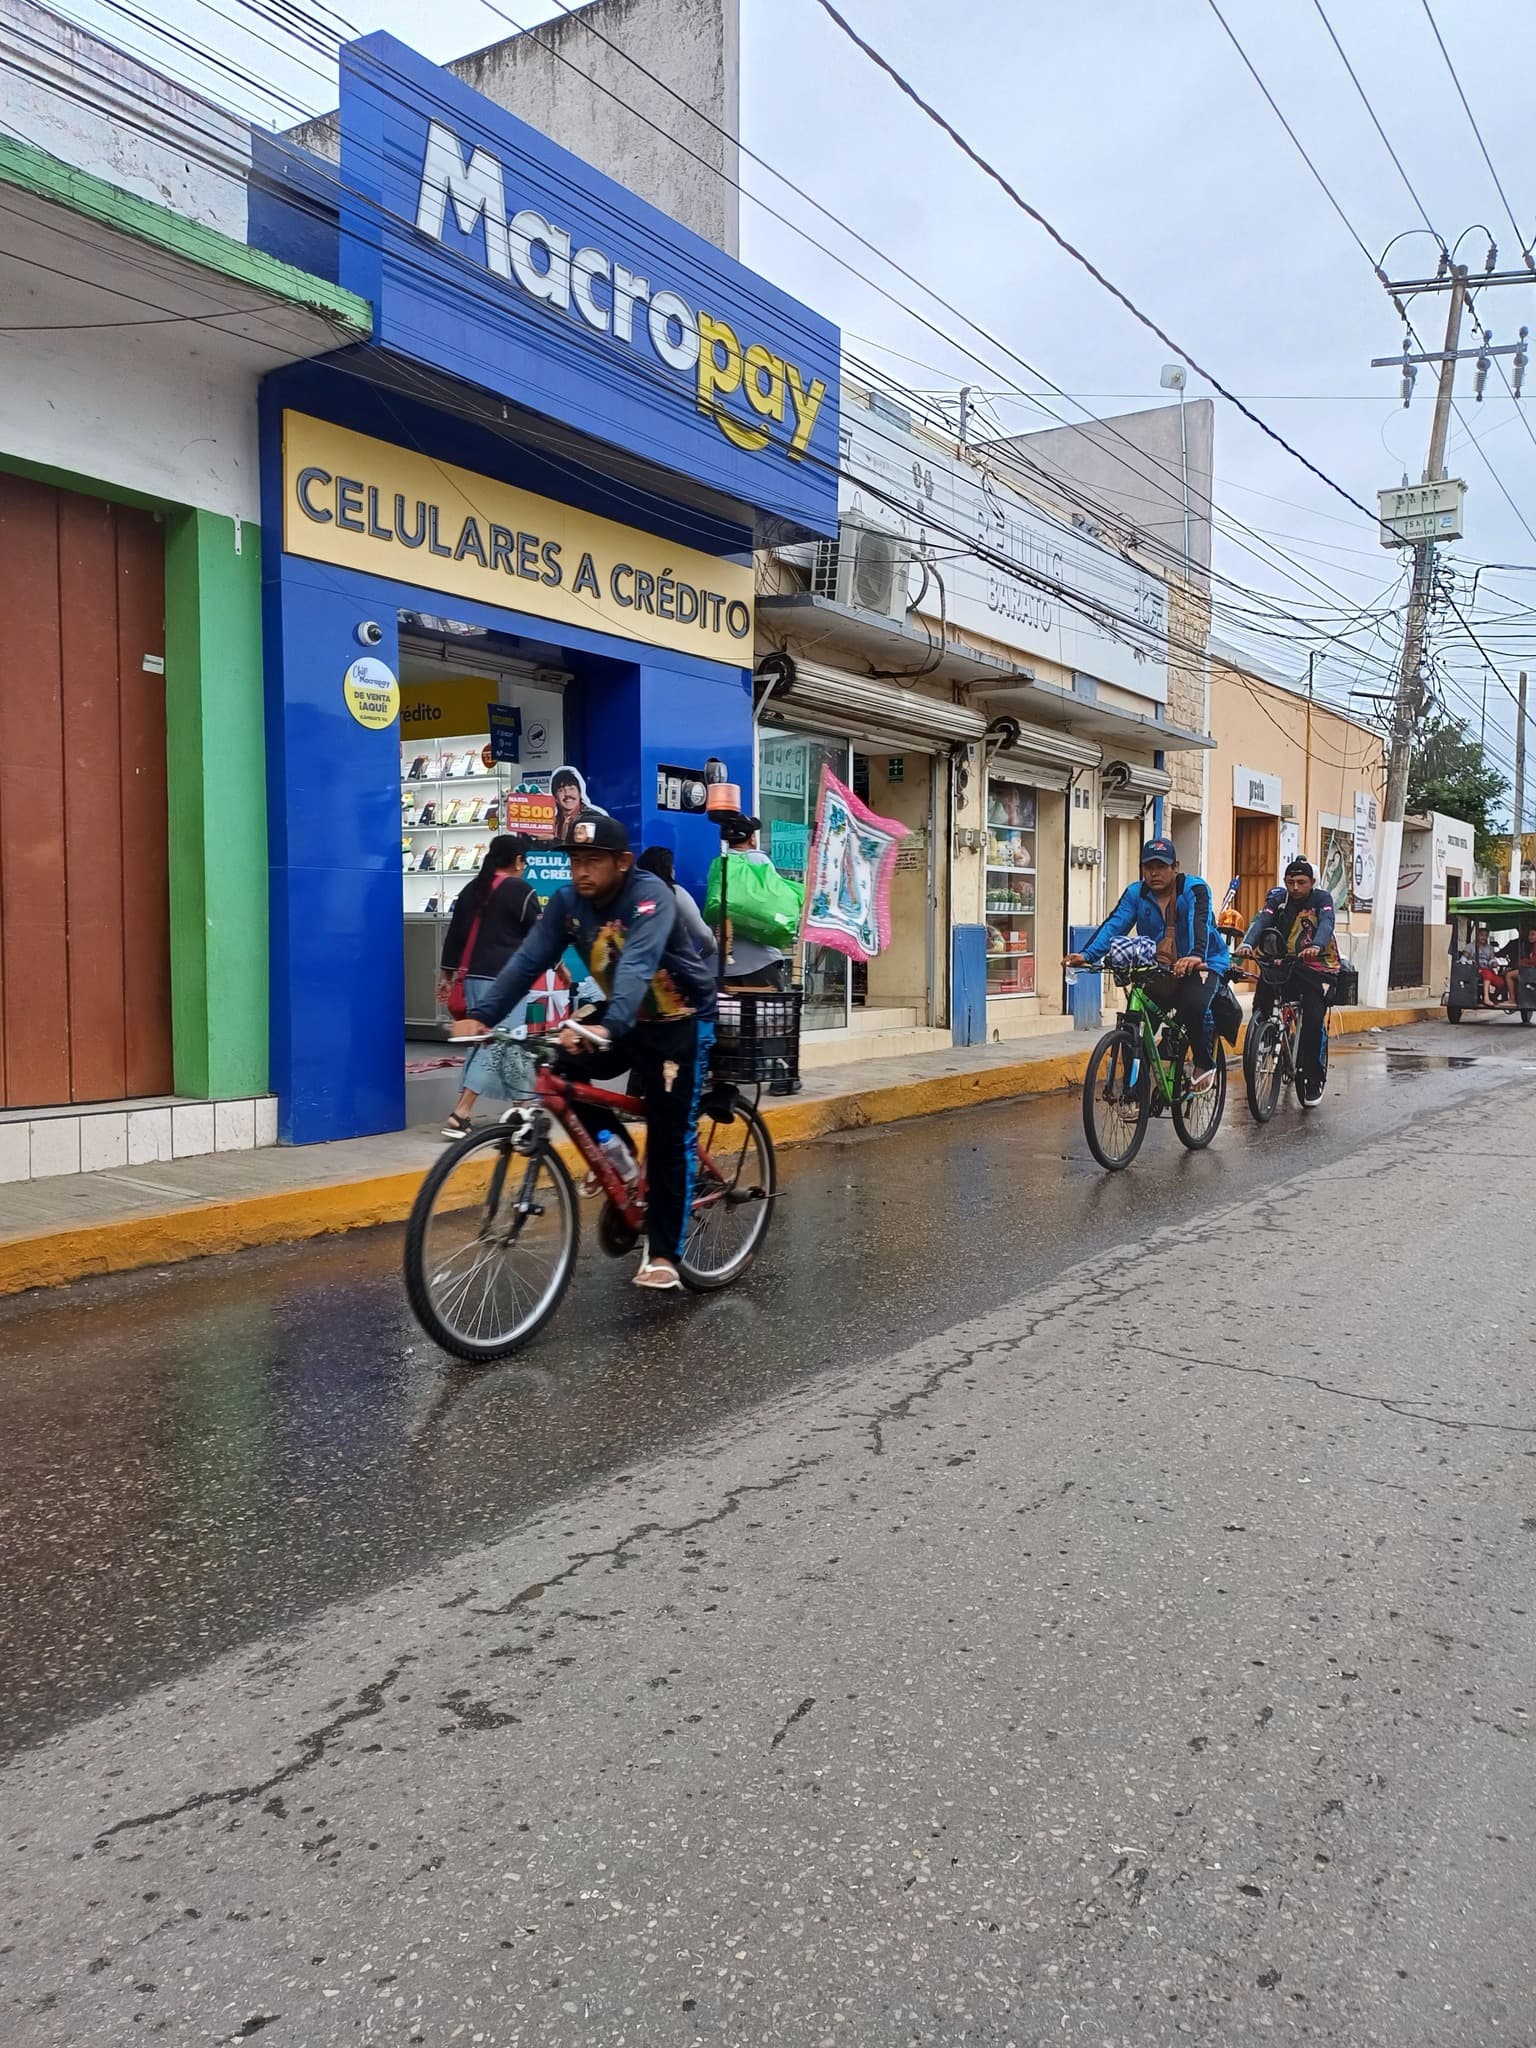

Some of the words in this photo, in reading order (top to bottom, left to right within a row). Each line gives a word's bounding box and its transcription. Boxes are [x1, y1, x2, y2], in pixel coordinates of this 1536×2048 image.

[415, 116, 827, 462] Macropay
[296, 466, 562, 587] CELULARES
[572, 553, 600, 598] A
[610, 567, 750, 639] CRÉDITO
[986, 568, 1052, 633] BARATO
[354, 691, 364, 699] DE
[366, 692, 391, 702] VENTA
[509, 803, 554, 819] $500
[526, 869, 538, 880] A
